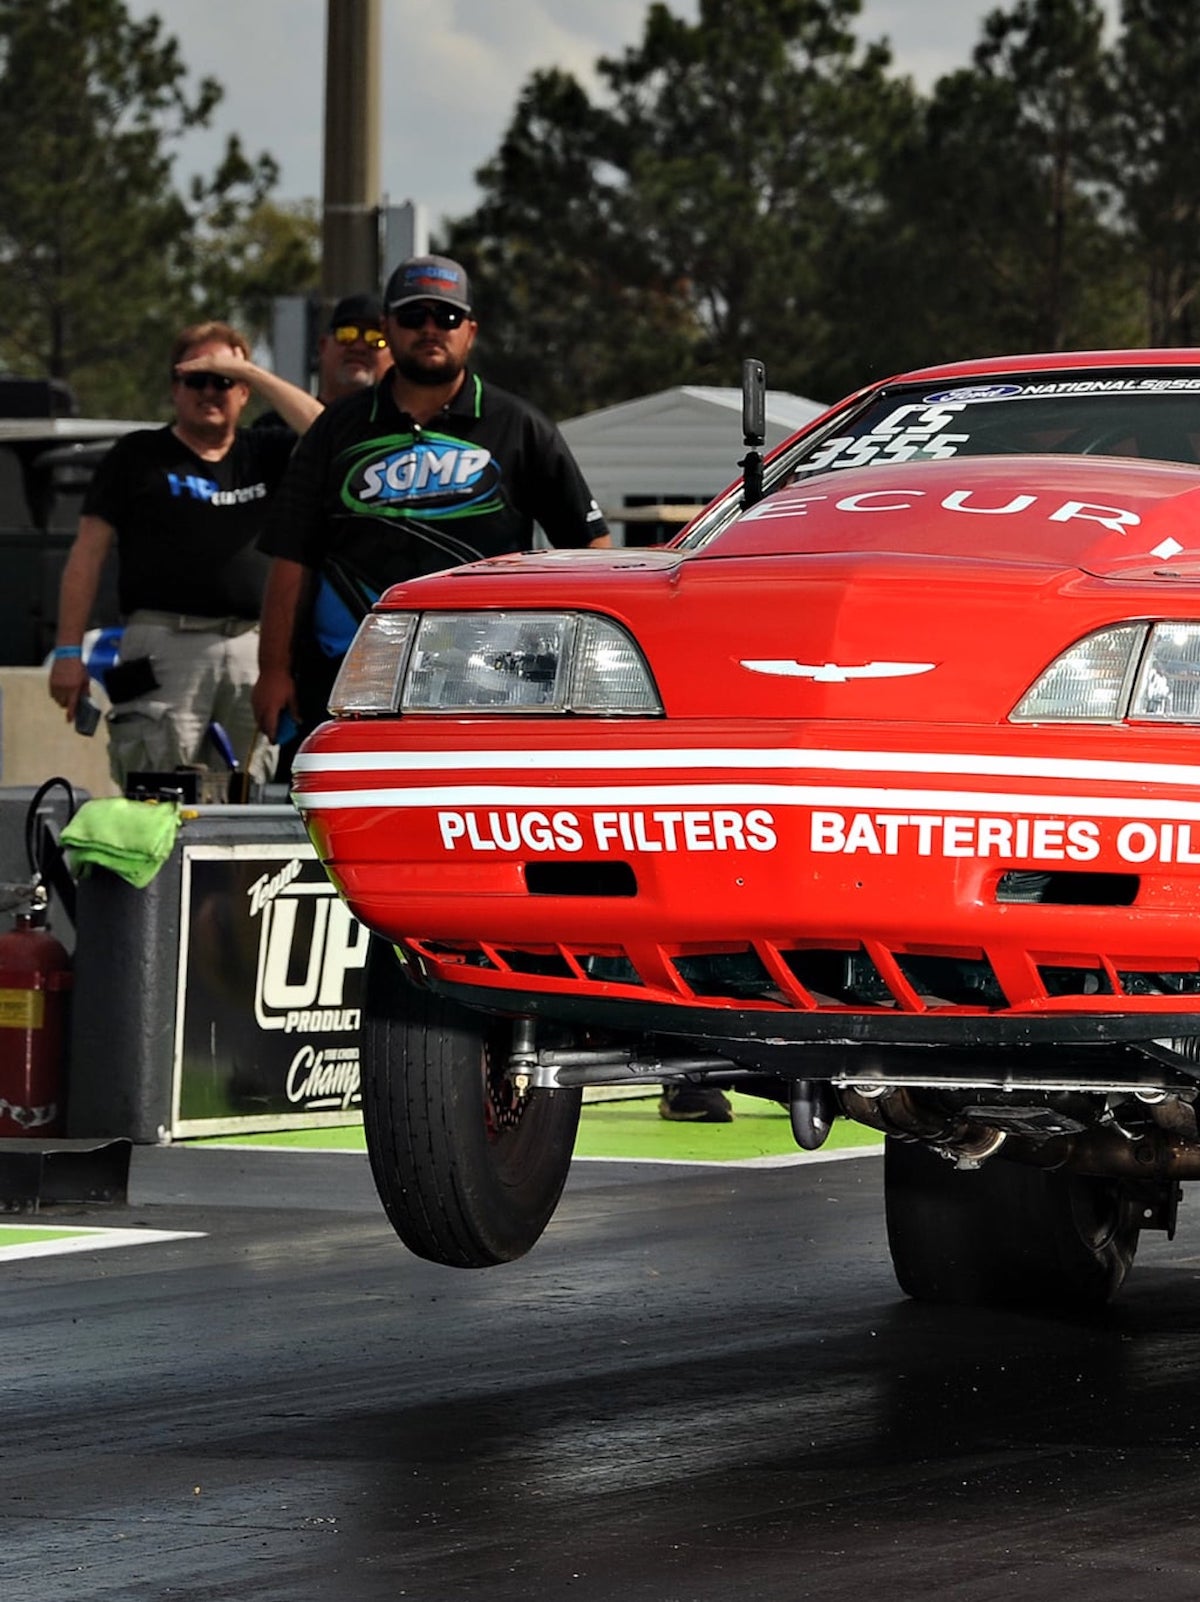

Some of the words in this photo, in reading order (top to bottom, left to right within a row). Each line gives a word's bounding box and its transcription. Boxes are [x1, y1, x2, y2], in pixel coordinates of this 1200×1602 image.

[871, 403, 967, 434] CS
[359, 449, 491, 499] SGMP
[437, 811, 583, 852] PLUGS
[592, 809, 778, 852] FILTERS
[810, 811, 1100, 861] BATTERIES
[247, 858, 303, 917] Team
[286, 1044, 361, 1110] Champ
